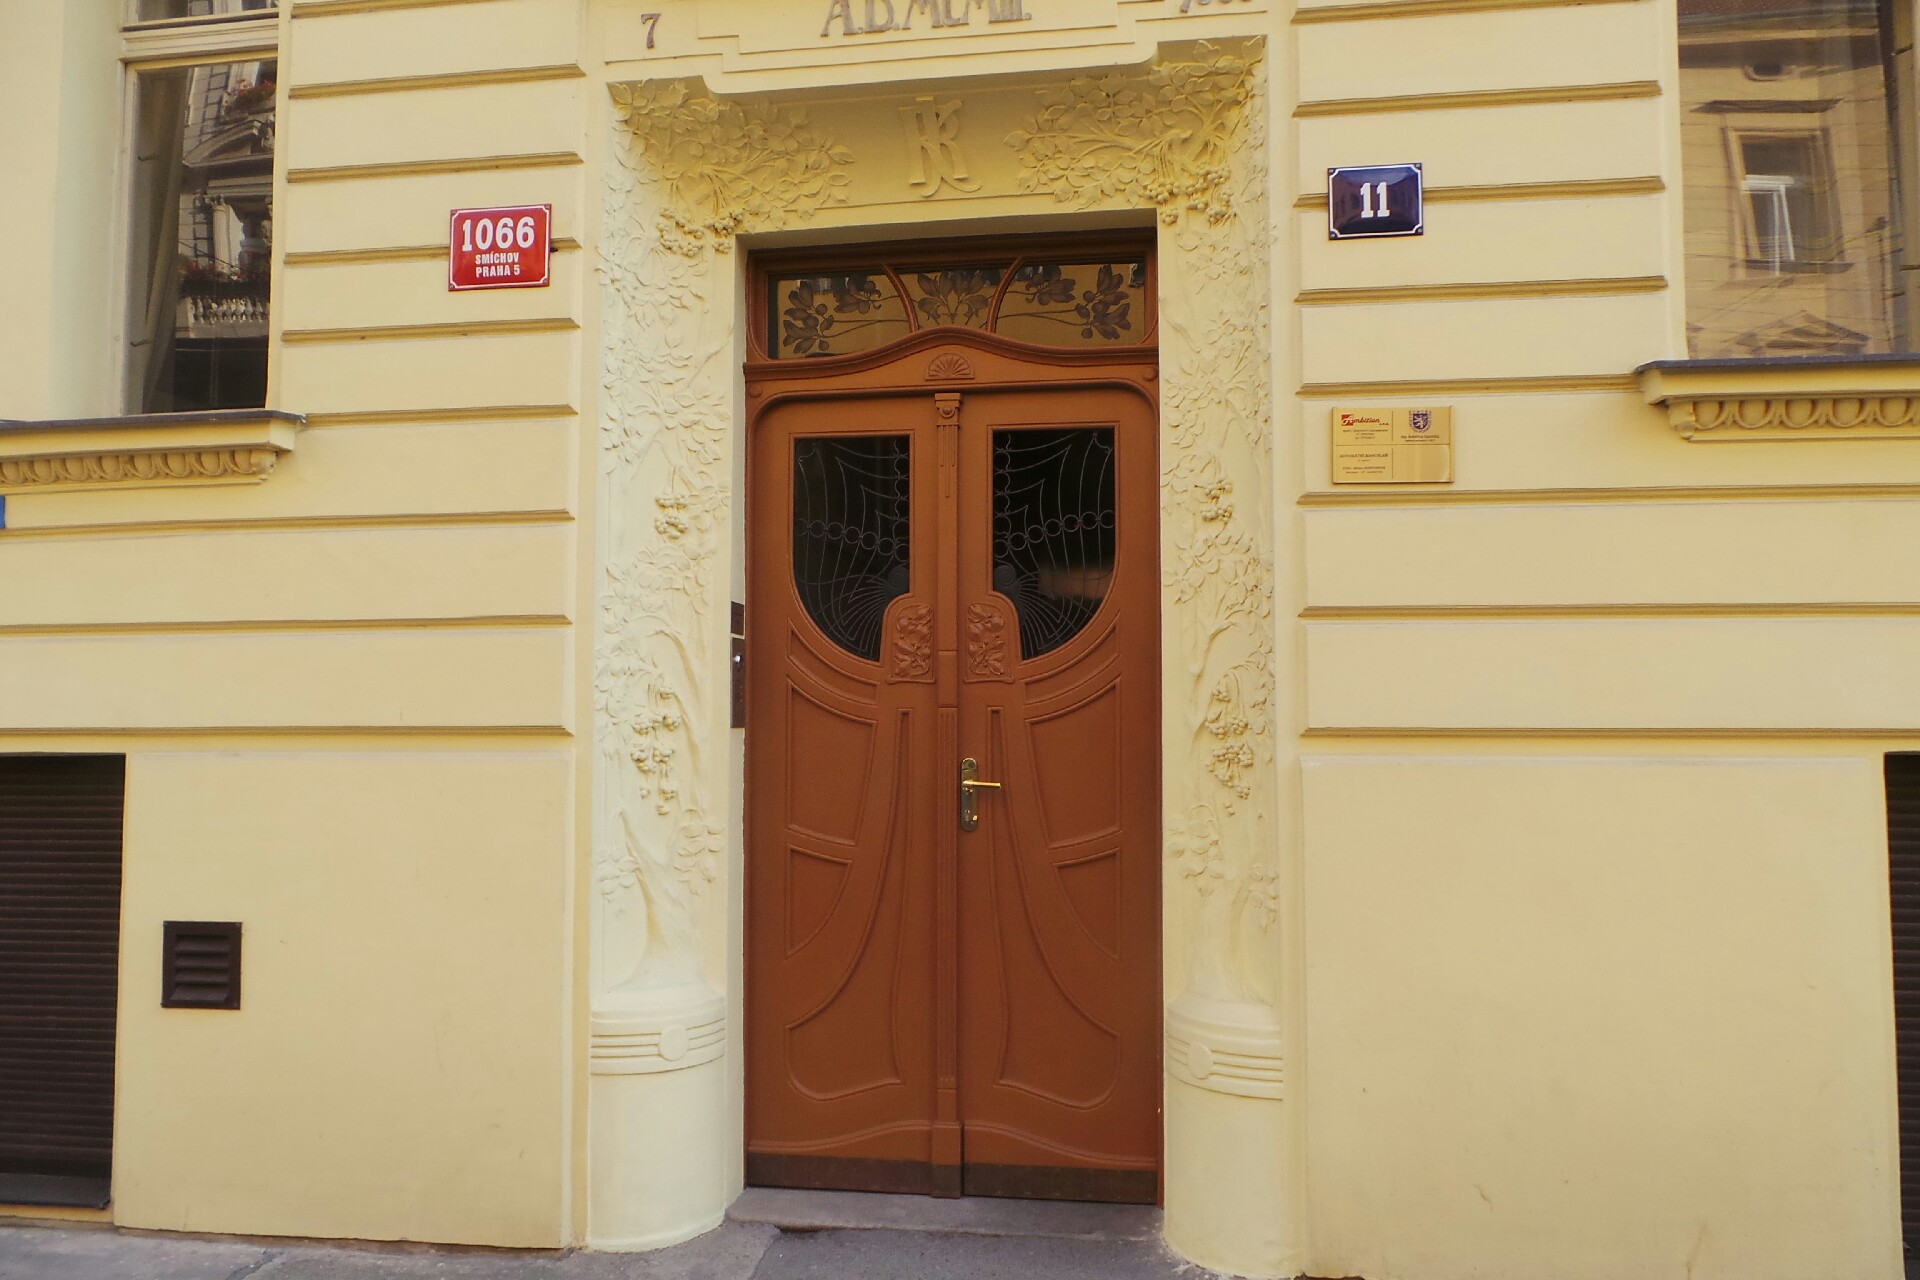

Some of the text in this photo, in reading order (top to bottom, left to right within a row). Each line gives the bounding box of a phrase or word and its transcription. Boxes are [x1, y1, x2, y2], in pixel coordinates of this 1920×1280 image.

[640, 12, 662, 49] 7
[1361, 182, 1390, 218] 11
[462, 217, 534, 251] 1066
[475, 252, 519, 264] SMÍCHOV
[475, 264, 520, 277] PRAHA 5
